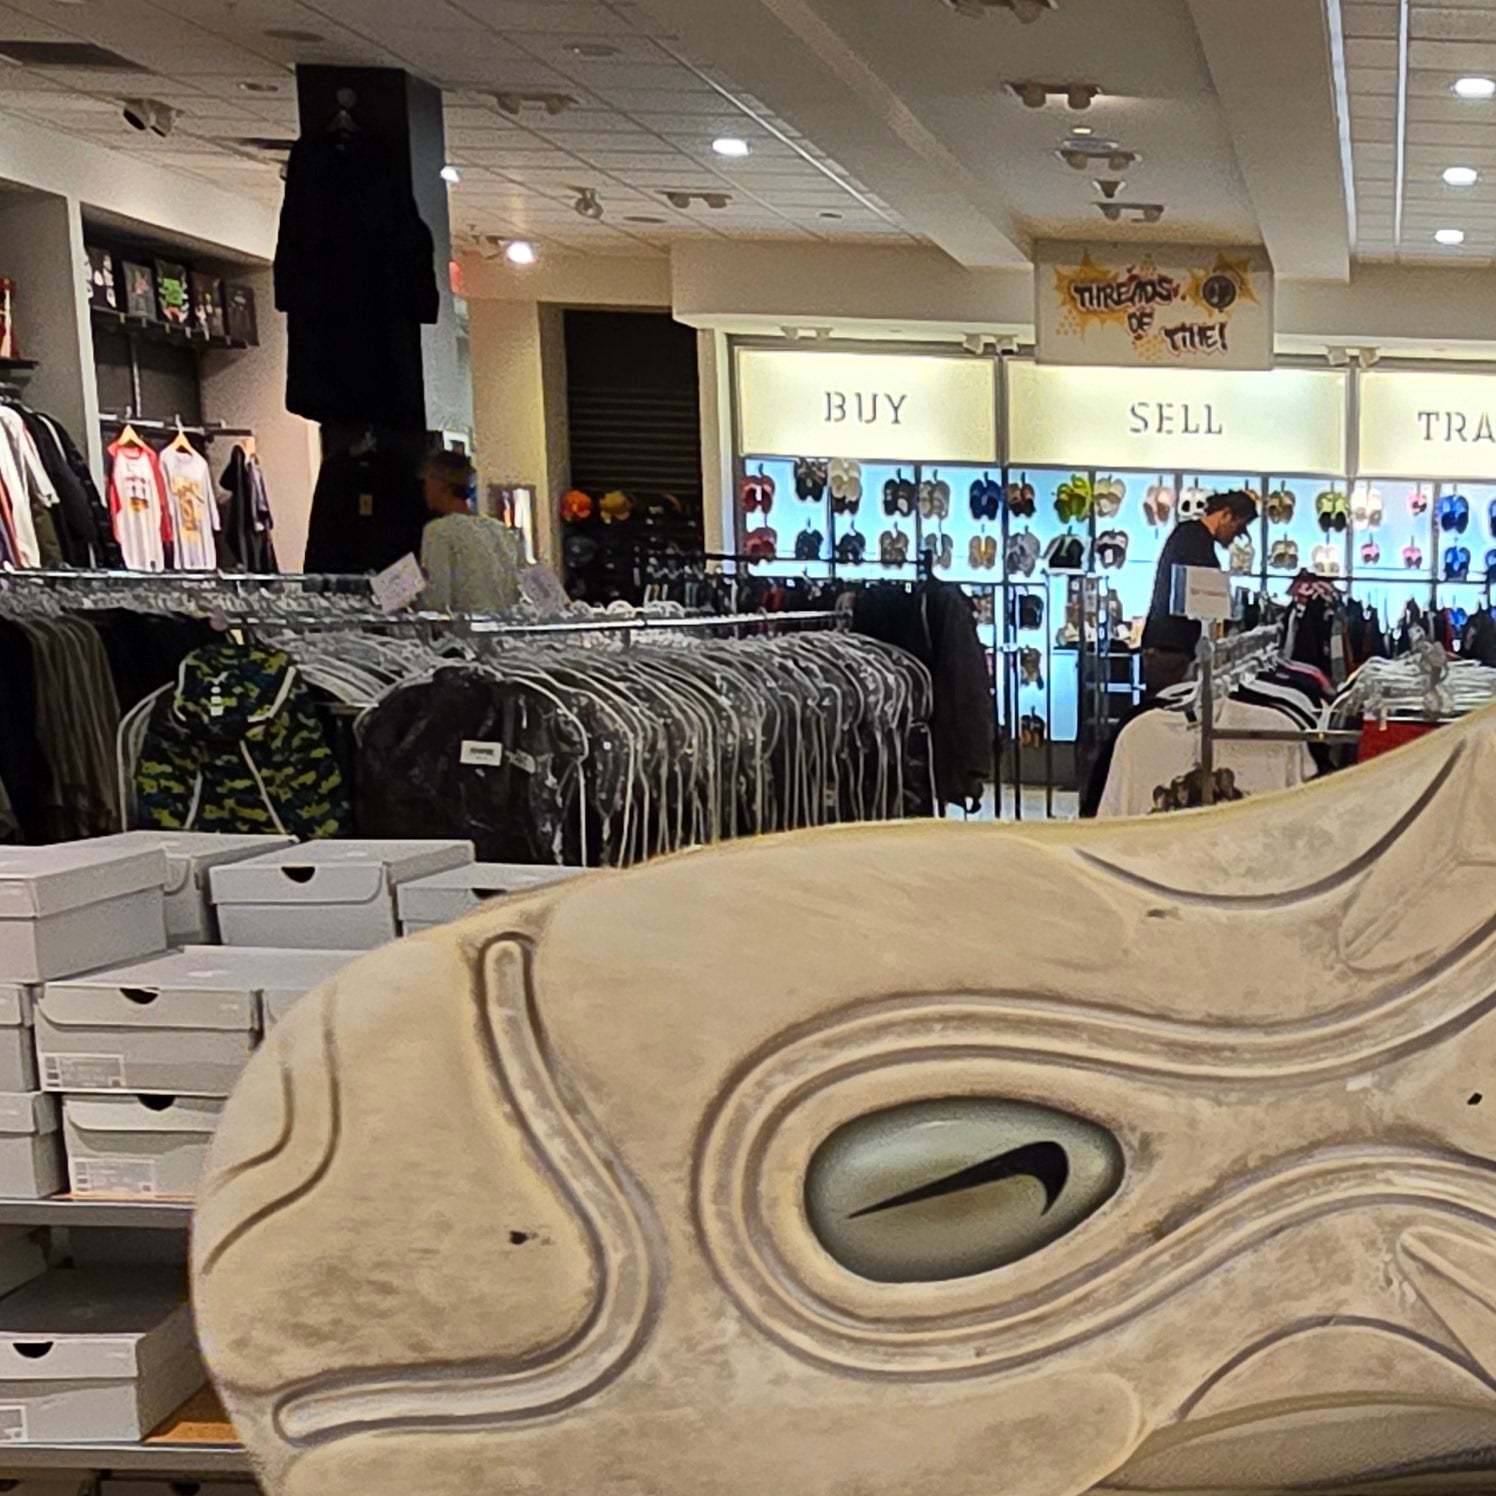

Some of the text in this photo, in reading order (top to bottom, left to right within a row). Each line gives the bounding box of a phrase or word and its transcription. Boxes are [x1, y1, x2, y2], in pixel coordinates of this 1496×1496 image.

[1073, 274, 1174, 309] THREADS
[823, 391, 908, 425] BUY
[1129, 401, 1224, 436] SELL
